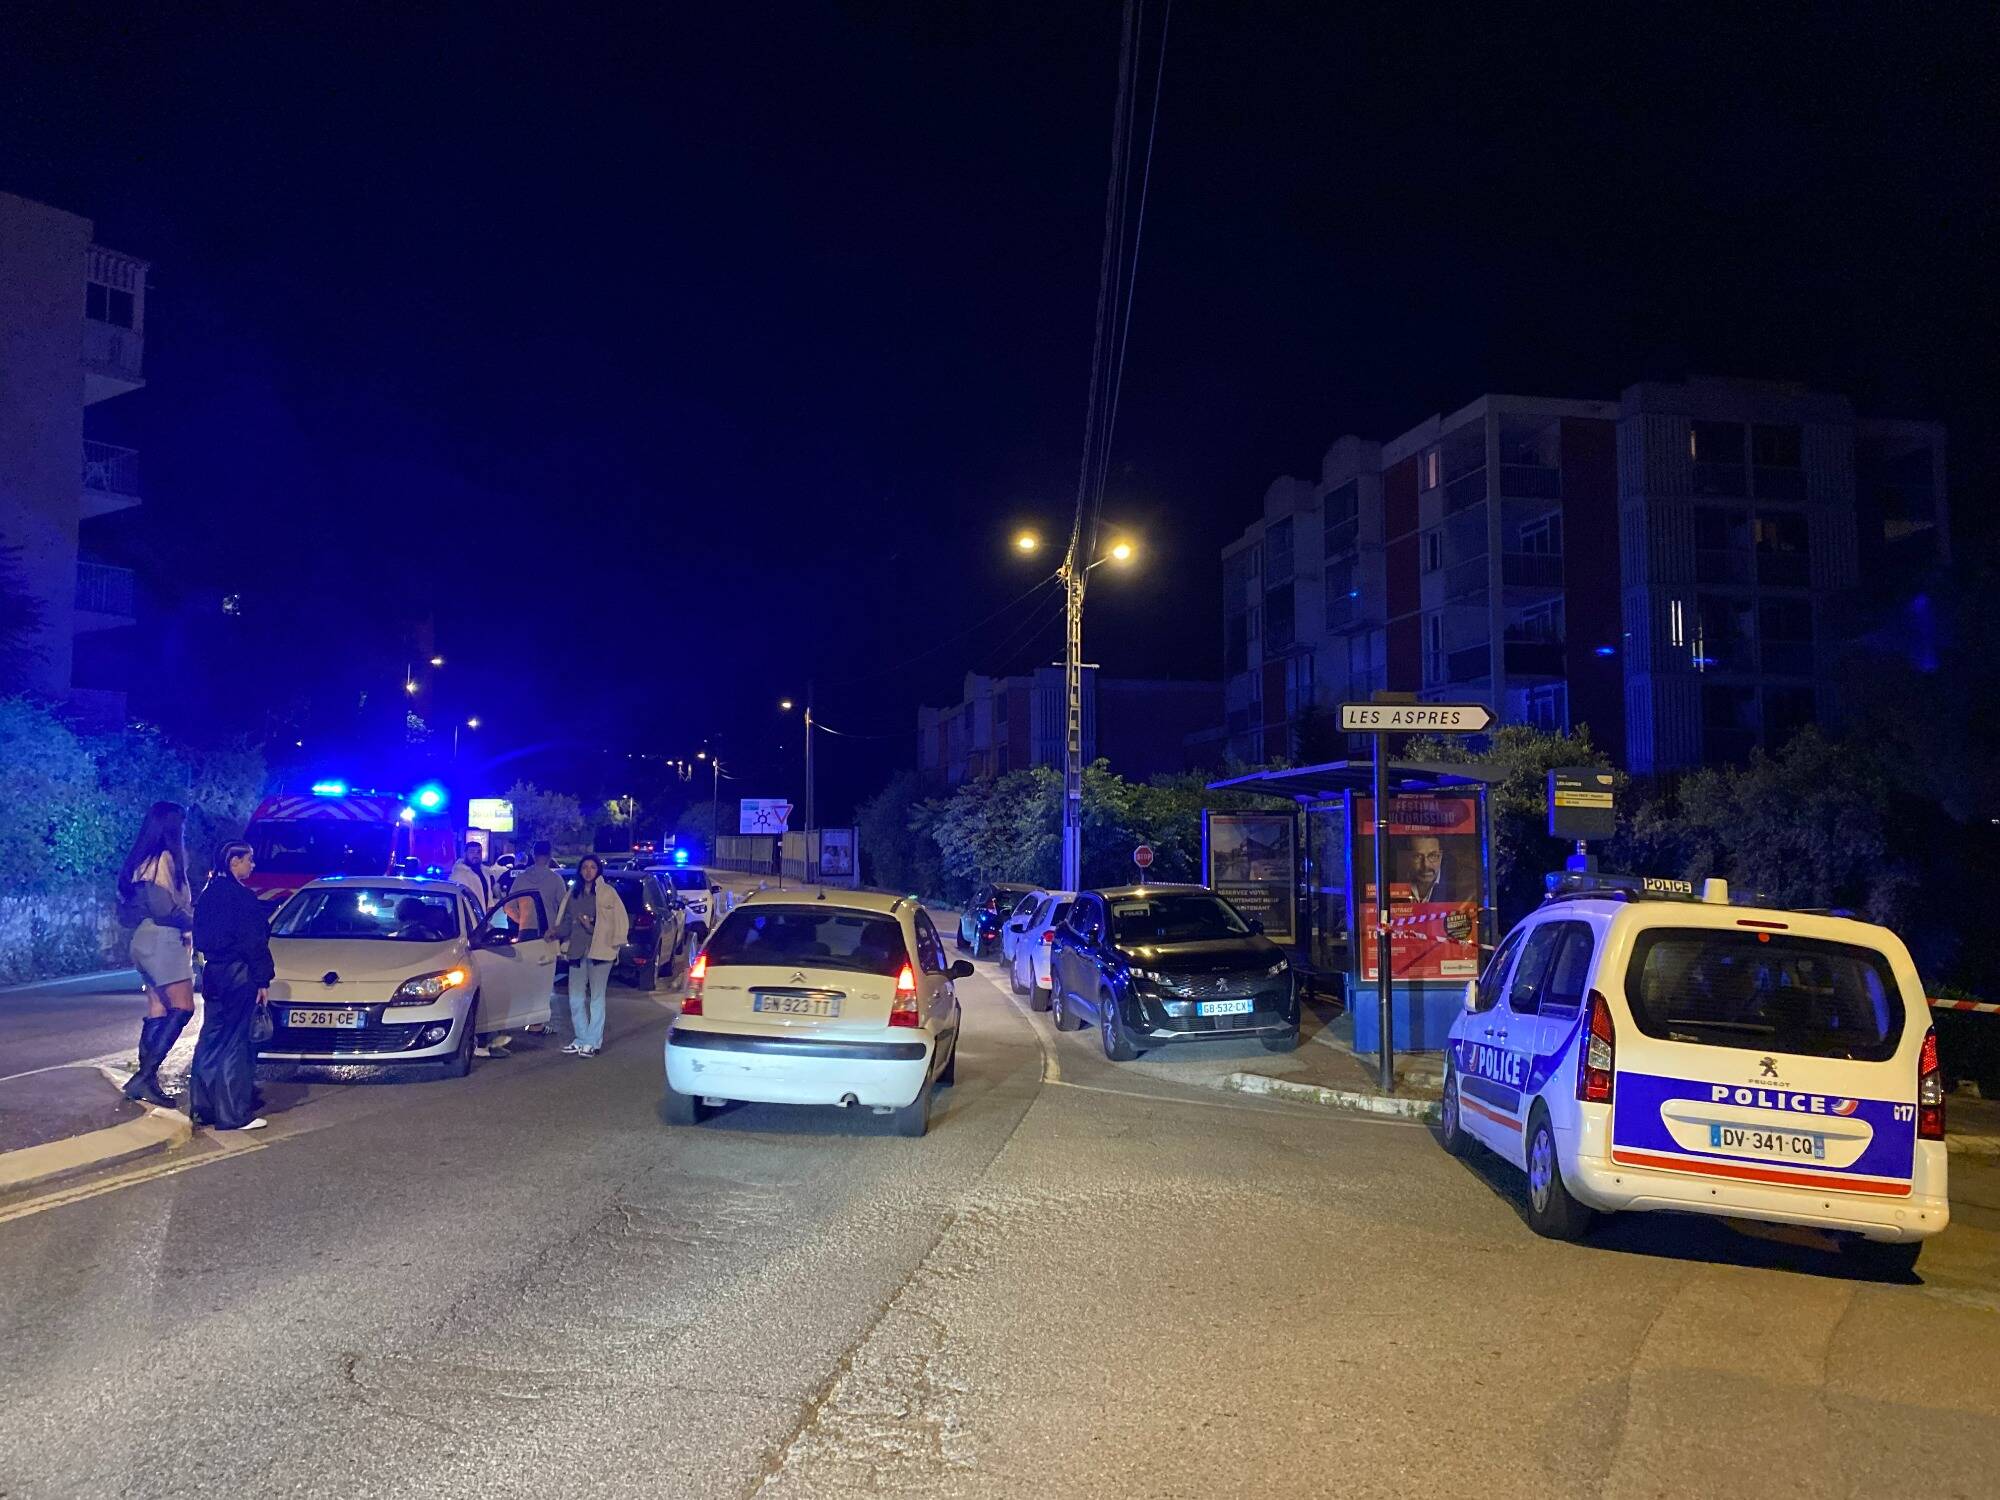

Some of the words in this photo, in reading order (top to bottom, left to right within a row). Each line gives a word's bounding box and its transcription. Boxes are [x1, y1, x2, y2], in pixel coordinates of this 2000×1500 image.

[1350, 710, 1380, 724] LES
[1392, 711, 1461, 725] ASPRES
[1396, 800, 1440, 811] FESTIVAL
[1136, 853, 1151, 861] STOP
[1646, 879, 1690, 892] POLICE
[1478, 1045, 1521, 1086] POLICE
[1748, 1078, 1792, 1088] PEUGEOT
[1711, 1085, 1826, 1113] POLICE
